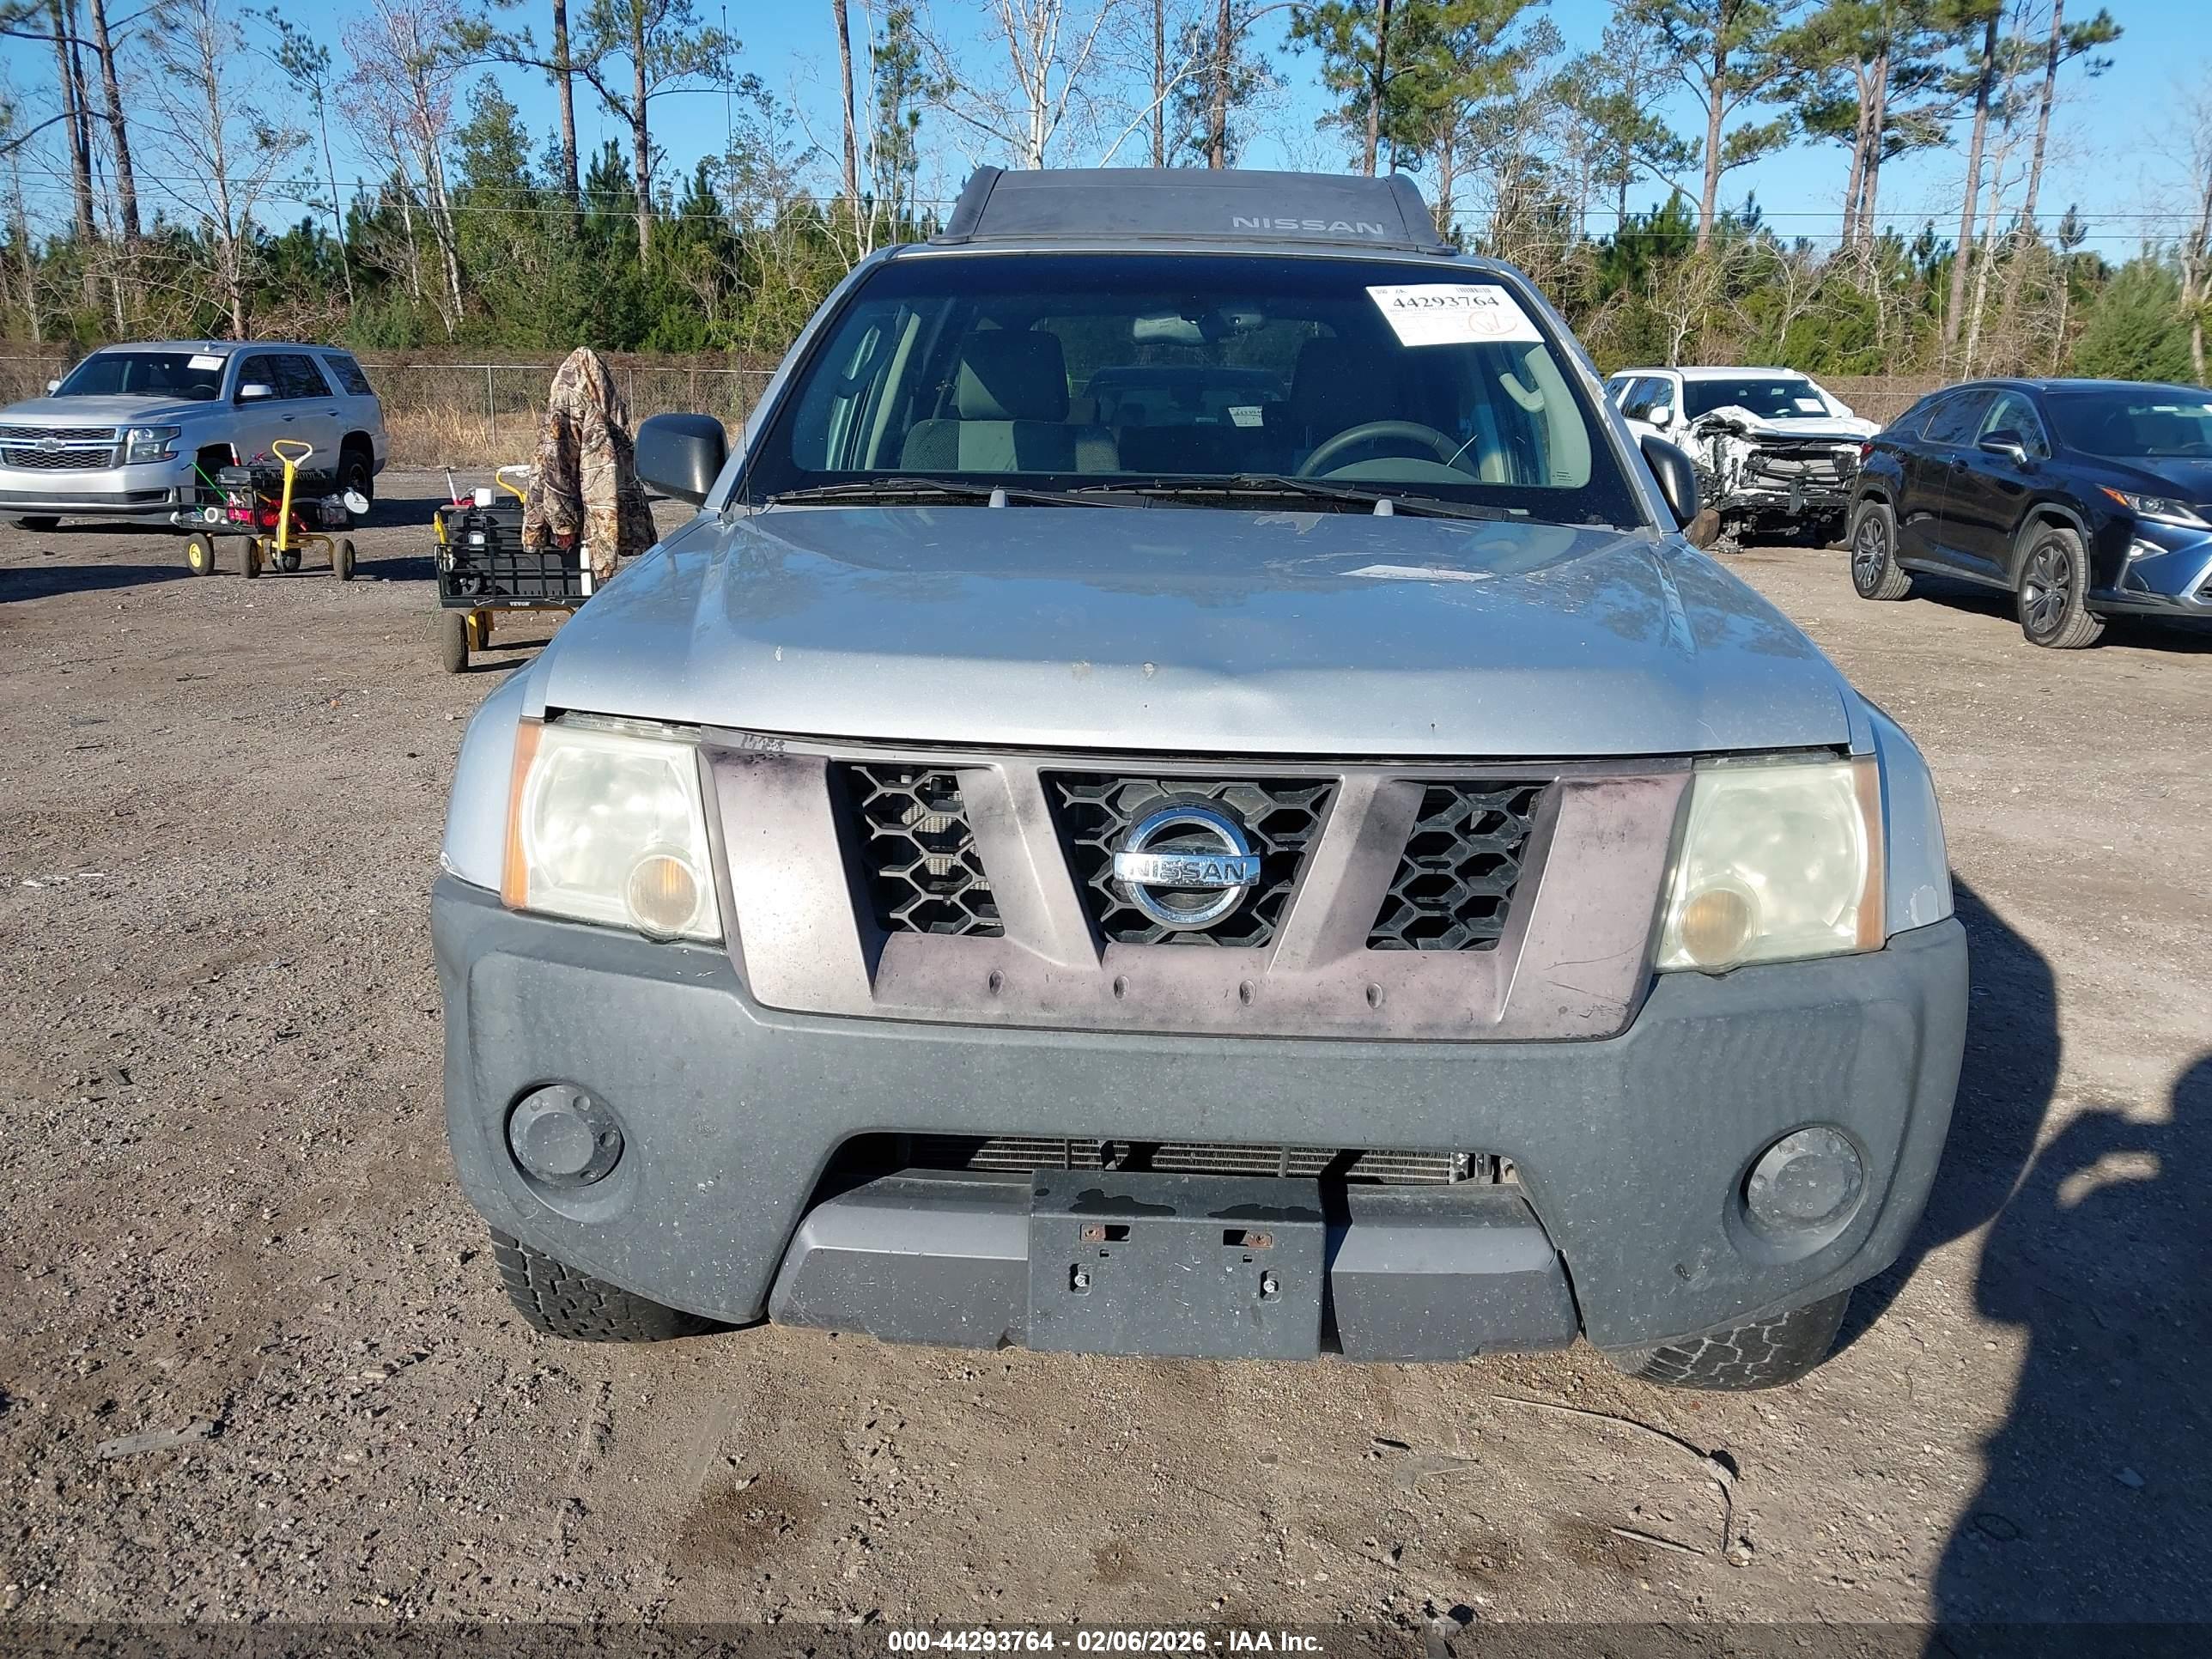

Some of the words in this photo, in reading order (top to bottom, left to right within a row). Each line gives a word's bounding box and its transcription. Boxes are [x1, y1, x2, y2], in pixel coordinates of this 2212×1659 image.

[1232, 216, 1384, 234] NISSAN
[1393, 296, 1500, 308] 44293764
[1127, 859, 1247, 881] NISSAN
